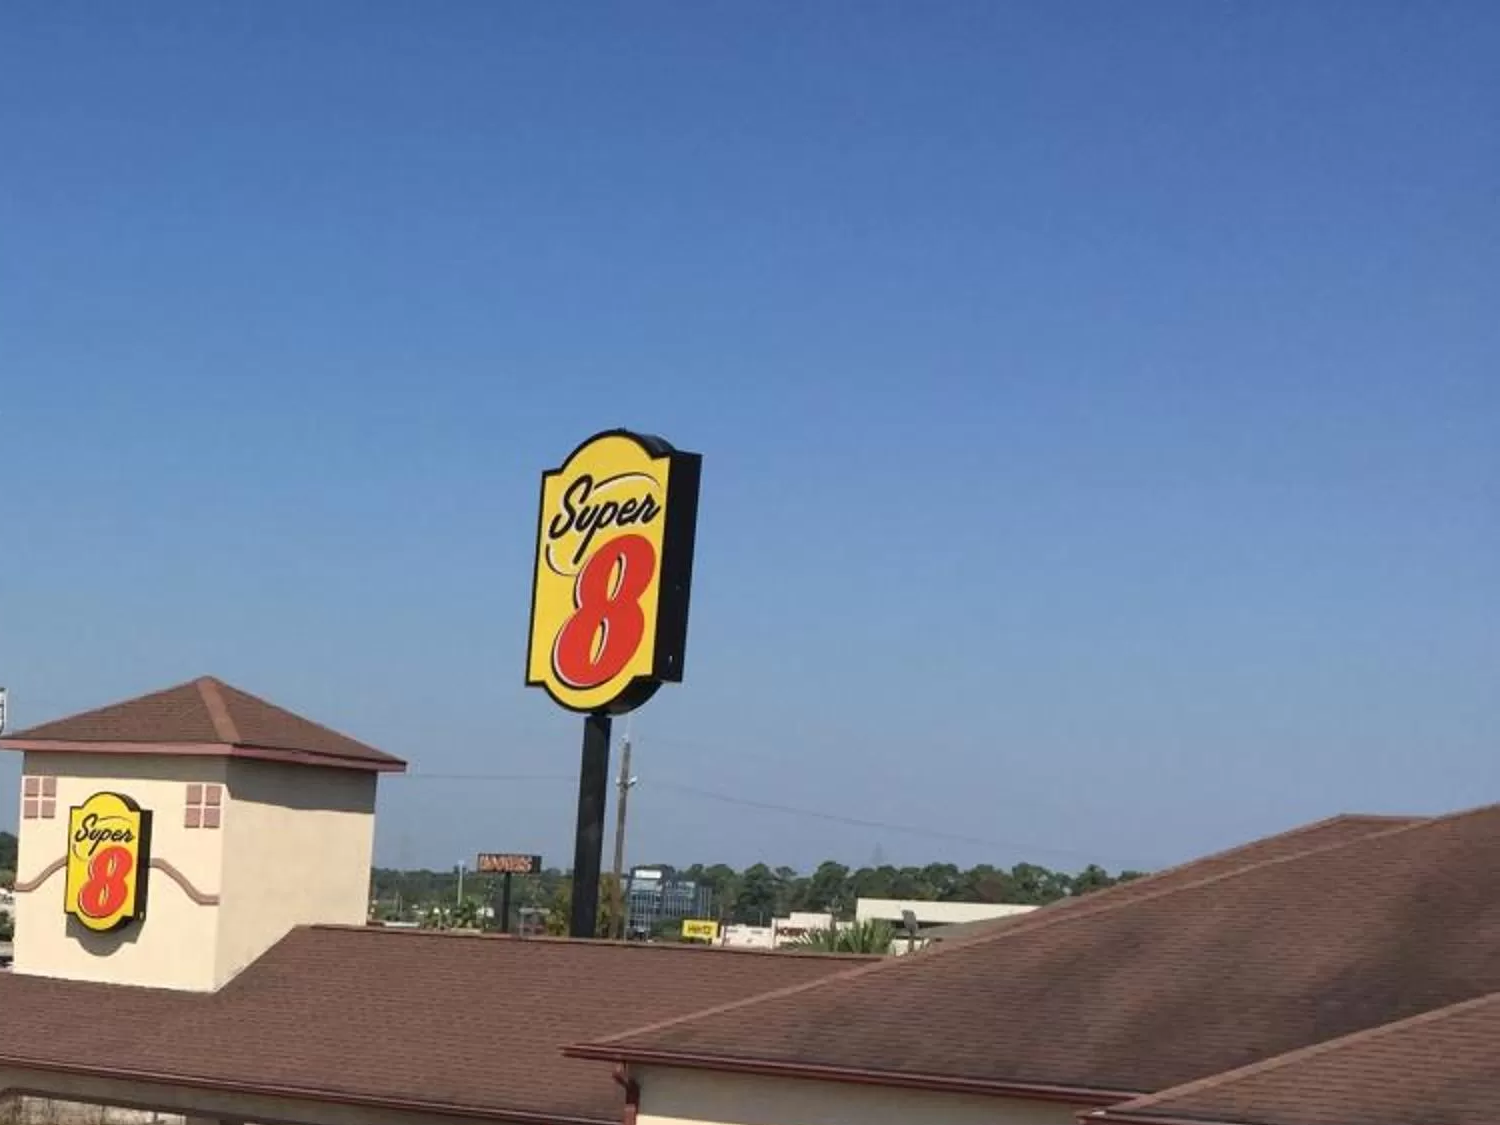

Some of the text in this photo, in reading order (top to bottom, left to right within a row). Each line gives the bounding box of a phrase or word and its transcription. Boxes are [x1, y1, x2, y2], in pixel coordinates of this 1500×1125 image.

[549, 475, 660, 563] Super
[551, 534, 656, 689] 8
[76, 813, 134, 856] Super
[77, 846, 133, 919] 8
